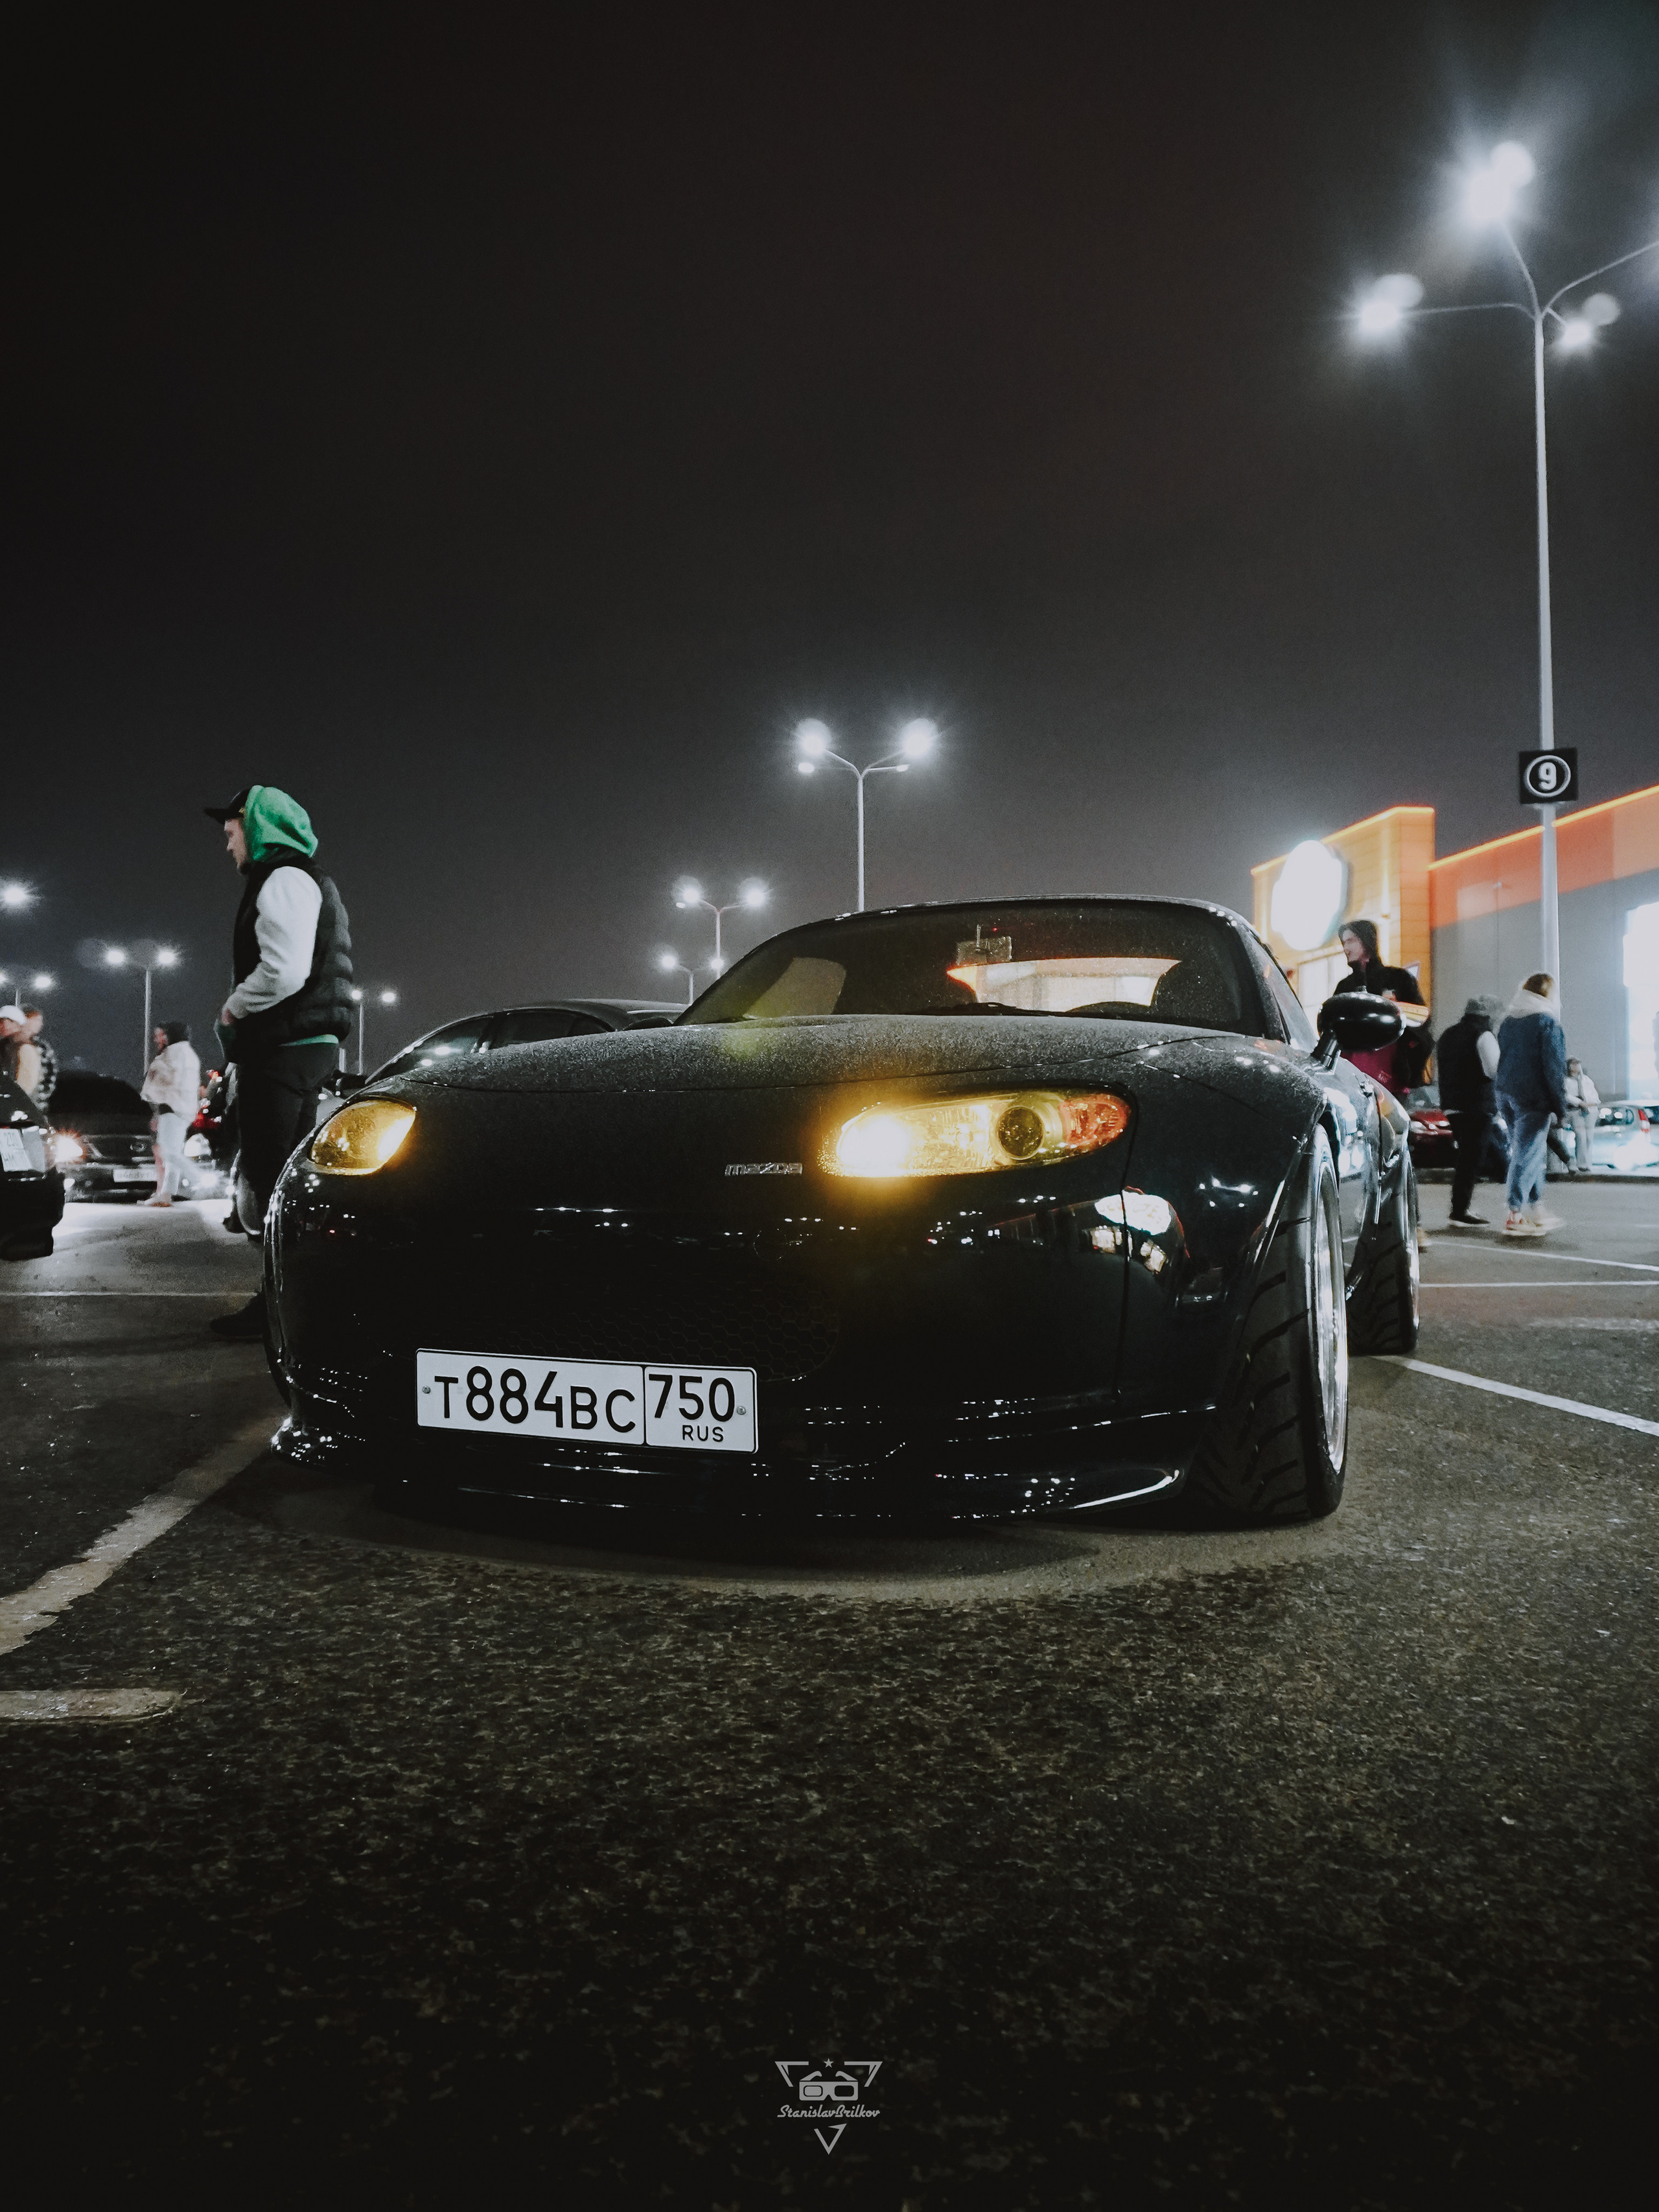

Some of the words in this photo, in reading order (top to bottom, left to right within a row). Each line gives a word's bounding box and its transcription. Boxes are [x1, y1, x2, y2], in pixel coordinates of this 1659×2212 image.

[1538, 762, 1557, 791] 9
[434, 1366, 636, 1434] T884BC
[649, 1373, 736, 1423] 750
[682, 1425, 725, 1443] RUS
